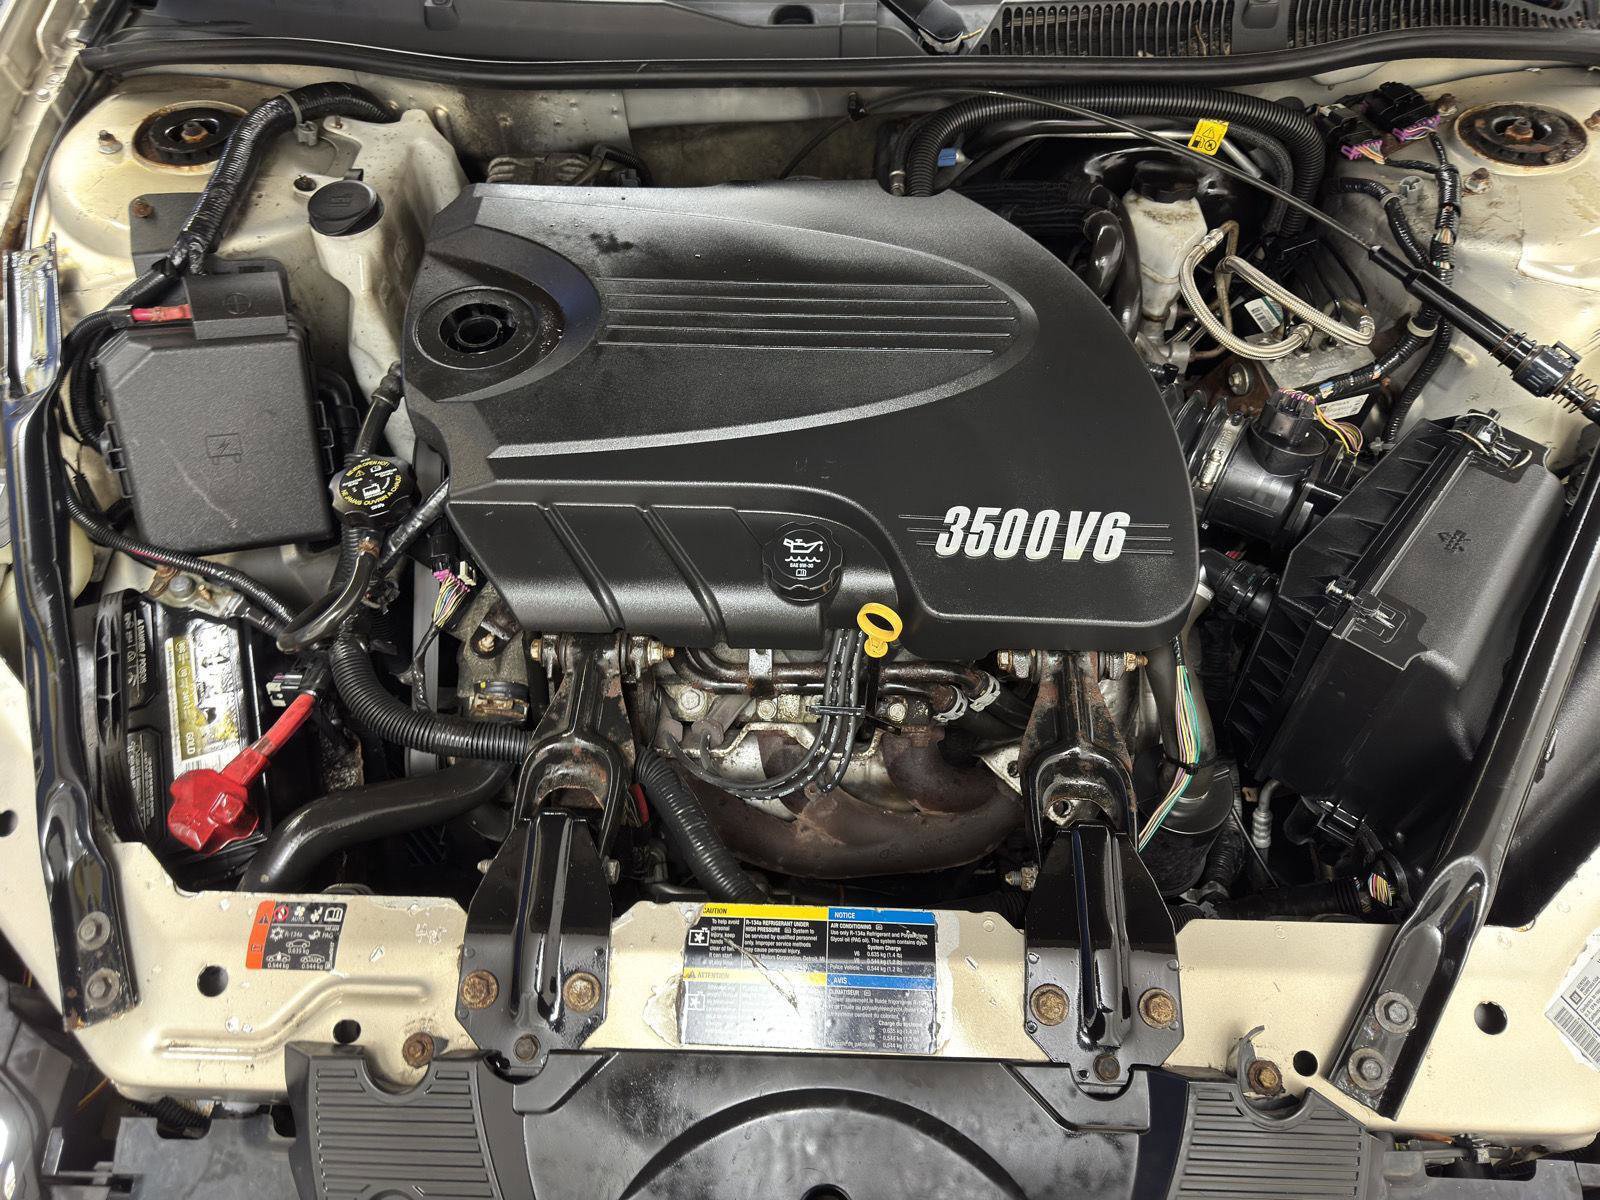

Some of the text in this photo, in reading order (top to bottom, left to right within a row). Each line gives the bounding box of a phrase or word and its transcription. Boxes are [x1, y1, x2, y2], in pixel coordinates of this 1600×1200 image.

[185, 731, 196, 755] GOLD
[834, 911, 856, 919] NOTICE
[718, 918, 728, 926] help
[728, 918, 740, 926] avoid
[768, 947, 787, 955] personal
[787, 948, 802, 956] injury.
[697, 970, 729, 979] ATTENTION
[833, 976, 848, 984] AVIS
